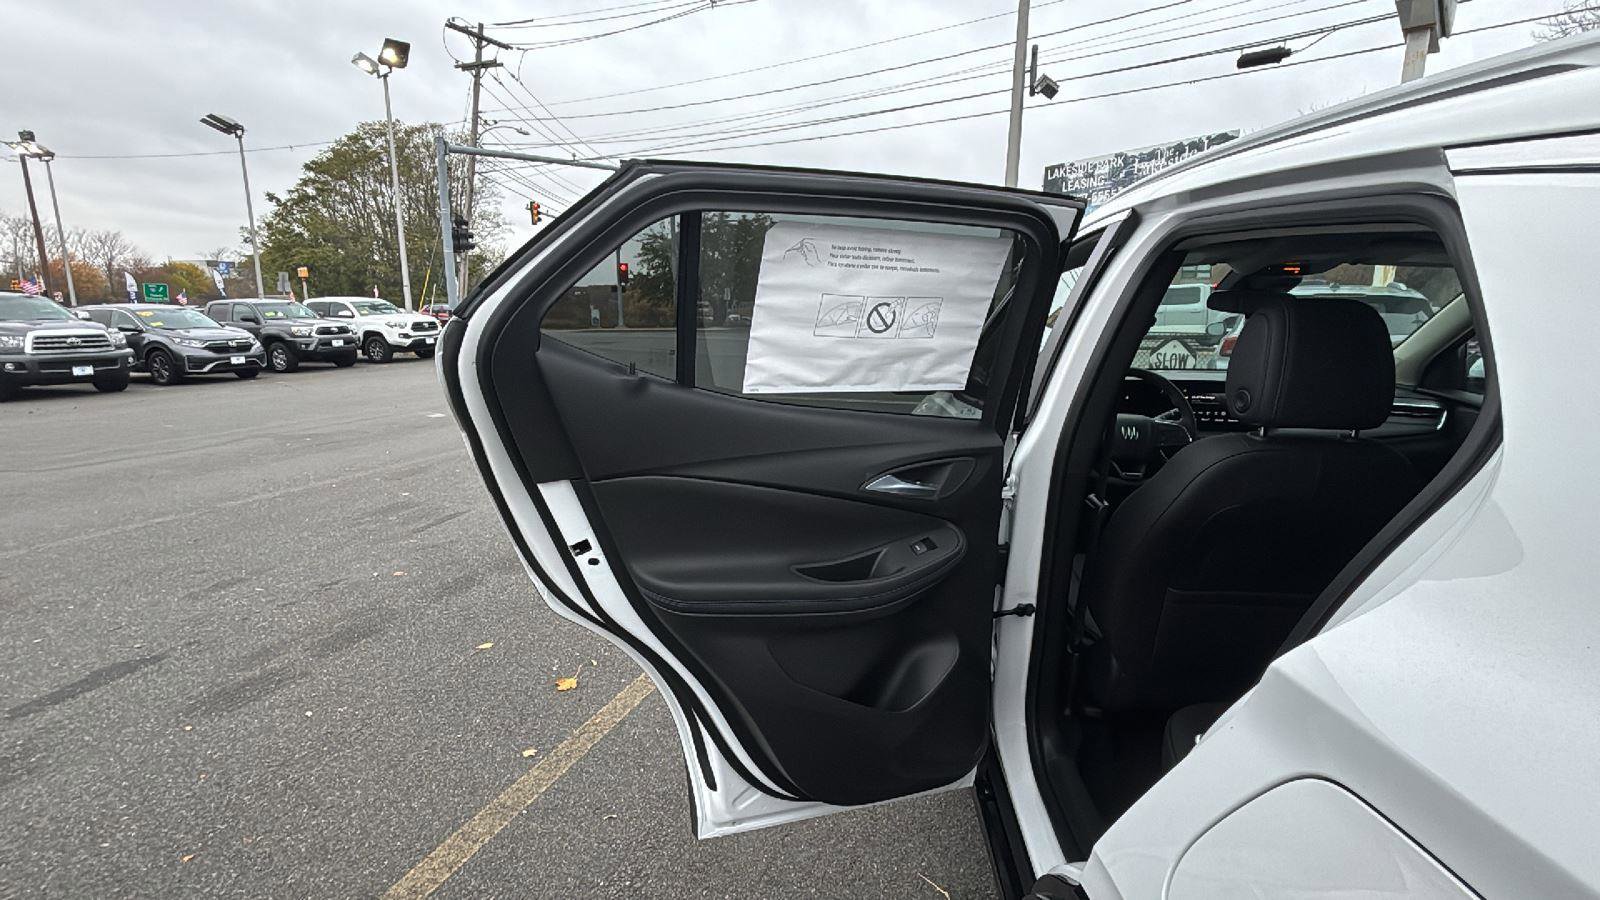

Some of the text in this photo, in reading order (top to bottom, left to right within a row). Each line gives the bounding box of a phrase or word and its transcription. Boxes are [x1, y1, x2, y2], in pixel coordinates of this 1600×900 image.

[1047, 153, 1125, 180] LAKESIDE PARK
[1062, 175, 1105, 192] LEASING
[1155, 352, 1190, 369] SLOW
